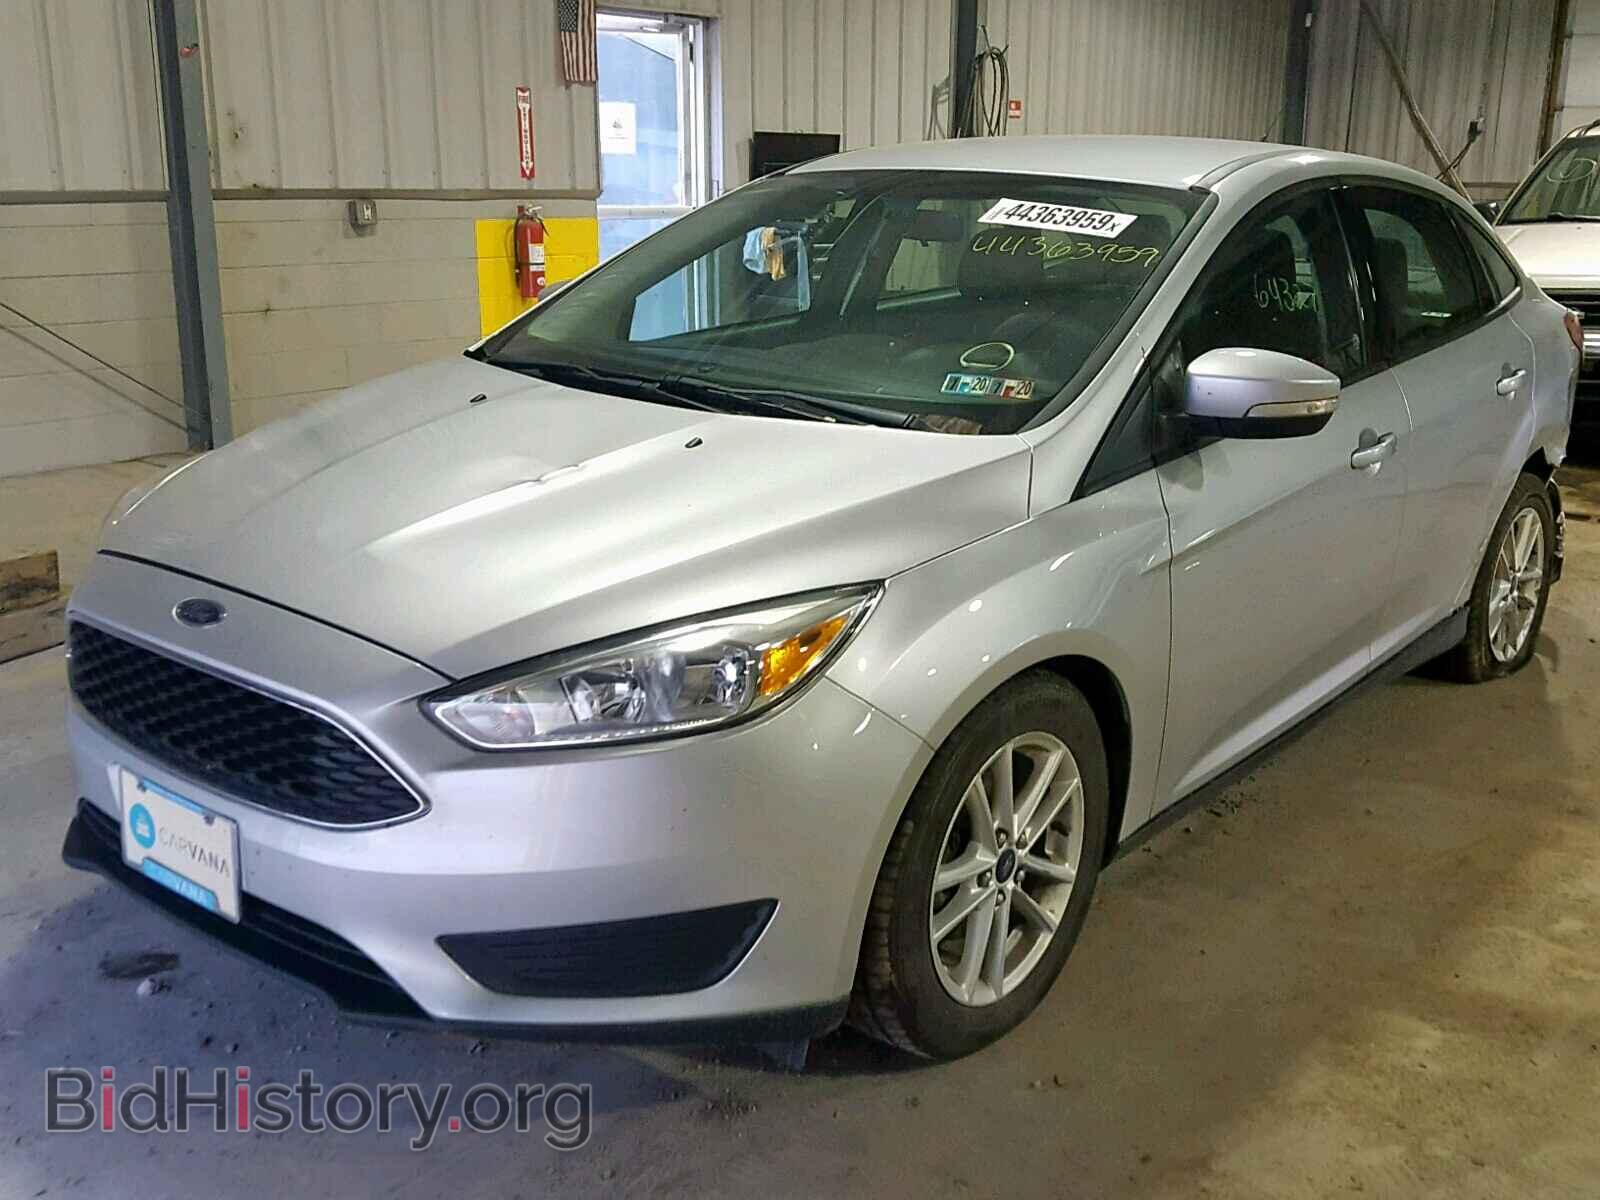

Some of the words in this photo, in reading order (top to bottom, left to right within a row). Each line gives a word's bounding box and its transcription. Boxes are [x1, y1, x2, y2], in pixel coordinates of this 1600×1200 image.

[973, 236, 1159, 268] 44363959
[971, 376, 987, 391] 20
[1017, 381, 1032, 396] 20
[158, 826, 231, 878] CARVANA
